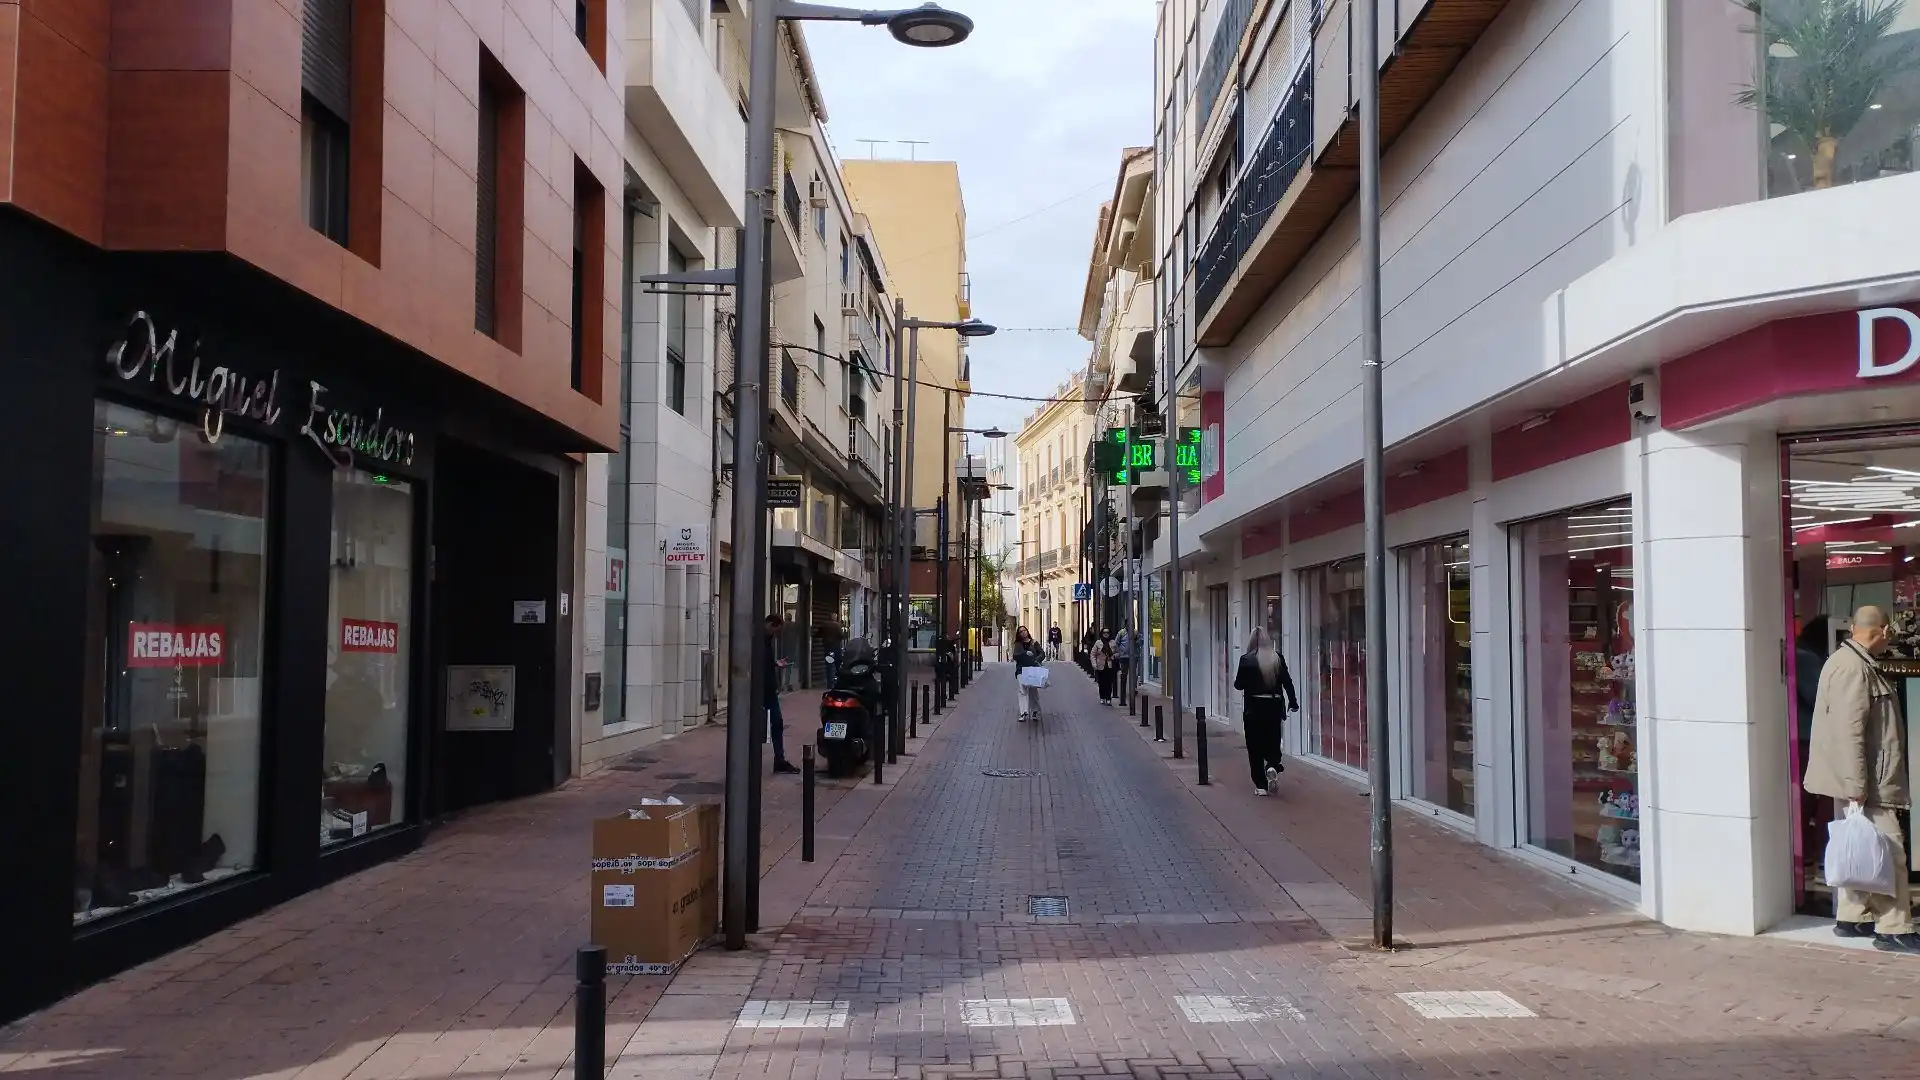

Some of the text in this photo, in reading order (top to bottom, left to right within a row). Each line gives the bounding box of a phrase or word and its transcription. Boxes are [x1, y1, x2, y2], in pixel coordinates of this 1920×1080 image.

[1857, 308, 1920, 377] D
[106, 310, 281, 443] Miguel
[133, 631, 220, 657] REBAJAS
[345, 625, 395, 648] REBAJAS
[616, 965, 644, 973] grados
